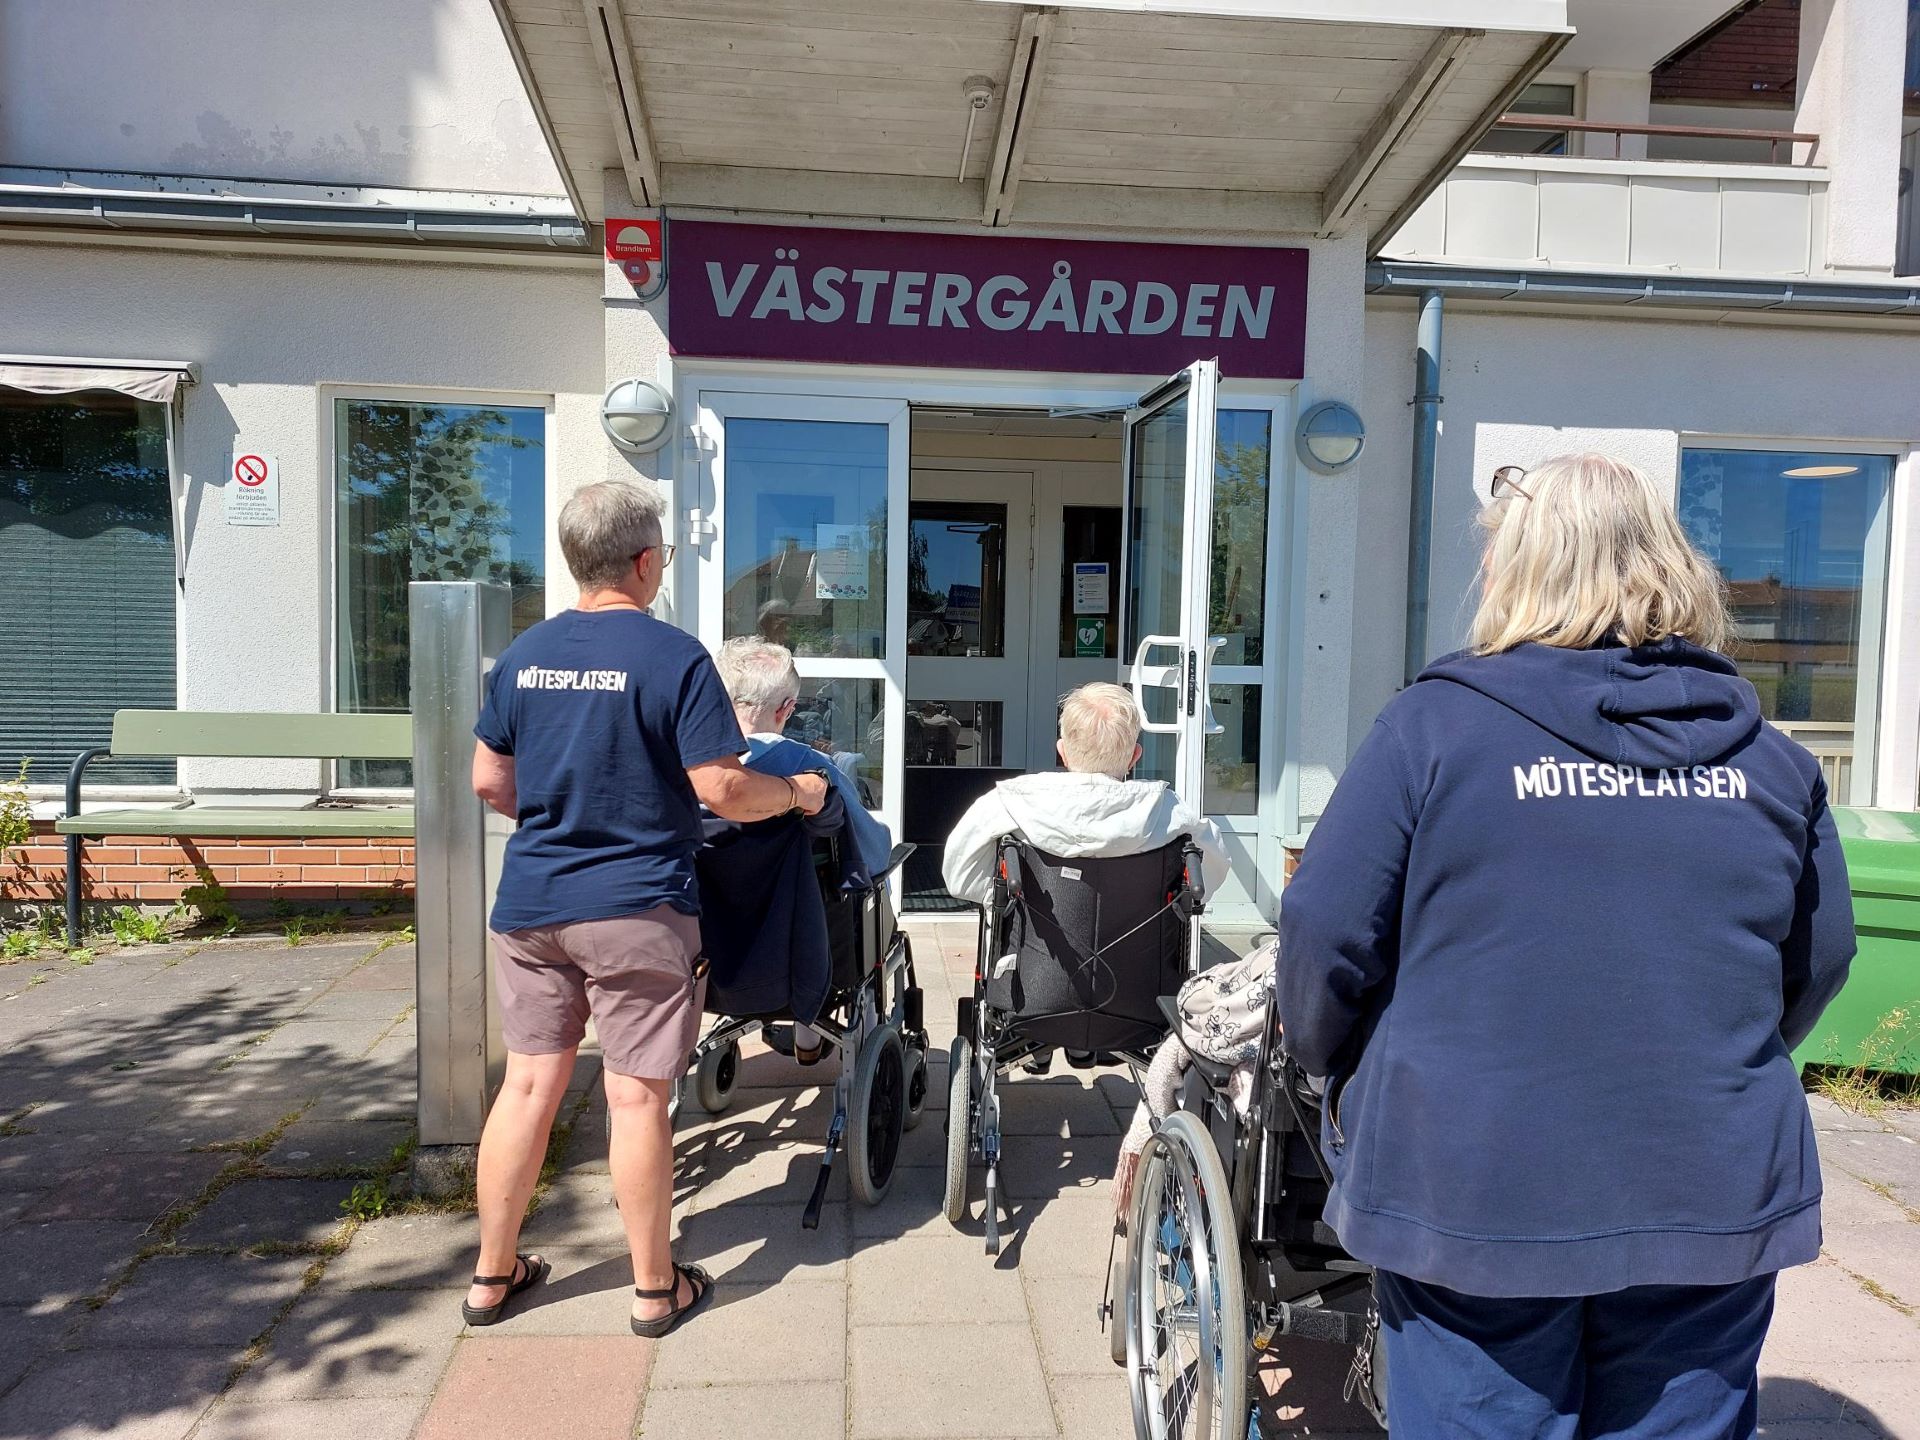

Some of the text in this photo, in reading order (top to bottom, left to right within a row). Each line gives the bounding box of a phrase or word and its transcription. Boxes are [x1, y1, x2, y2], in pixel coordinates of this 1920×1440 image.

[615, 245, 652, 253] Brandlarm
[705, 247, 1276, 340] VÄSTERGÅRDEN
[238, 486, 265, 494] Rökning
[516, 665, 628, 692] MÖTESPLATSEN
[1513, 756, 1747, 800] MÖTESPLATSEN
